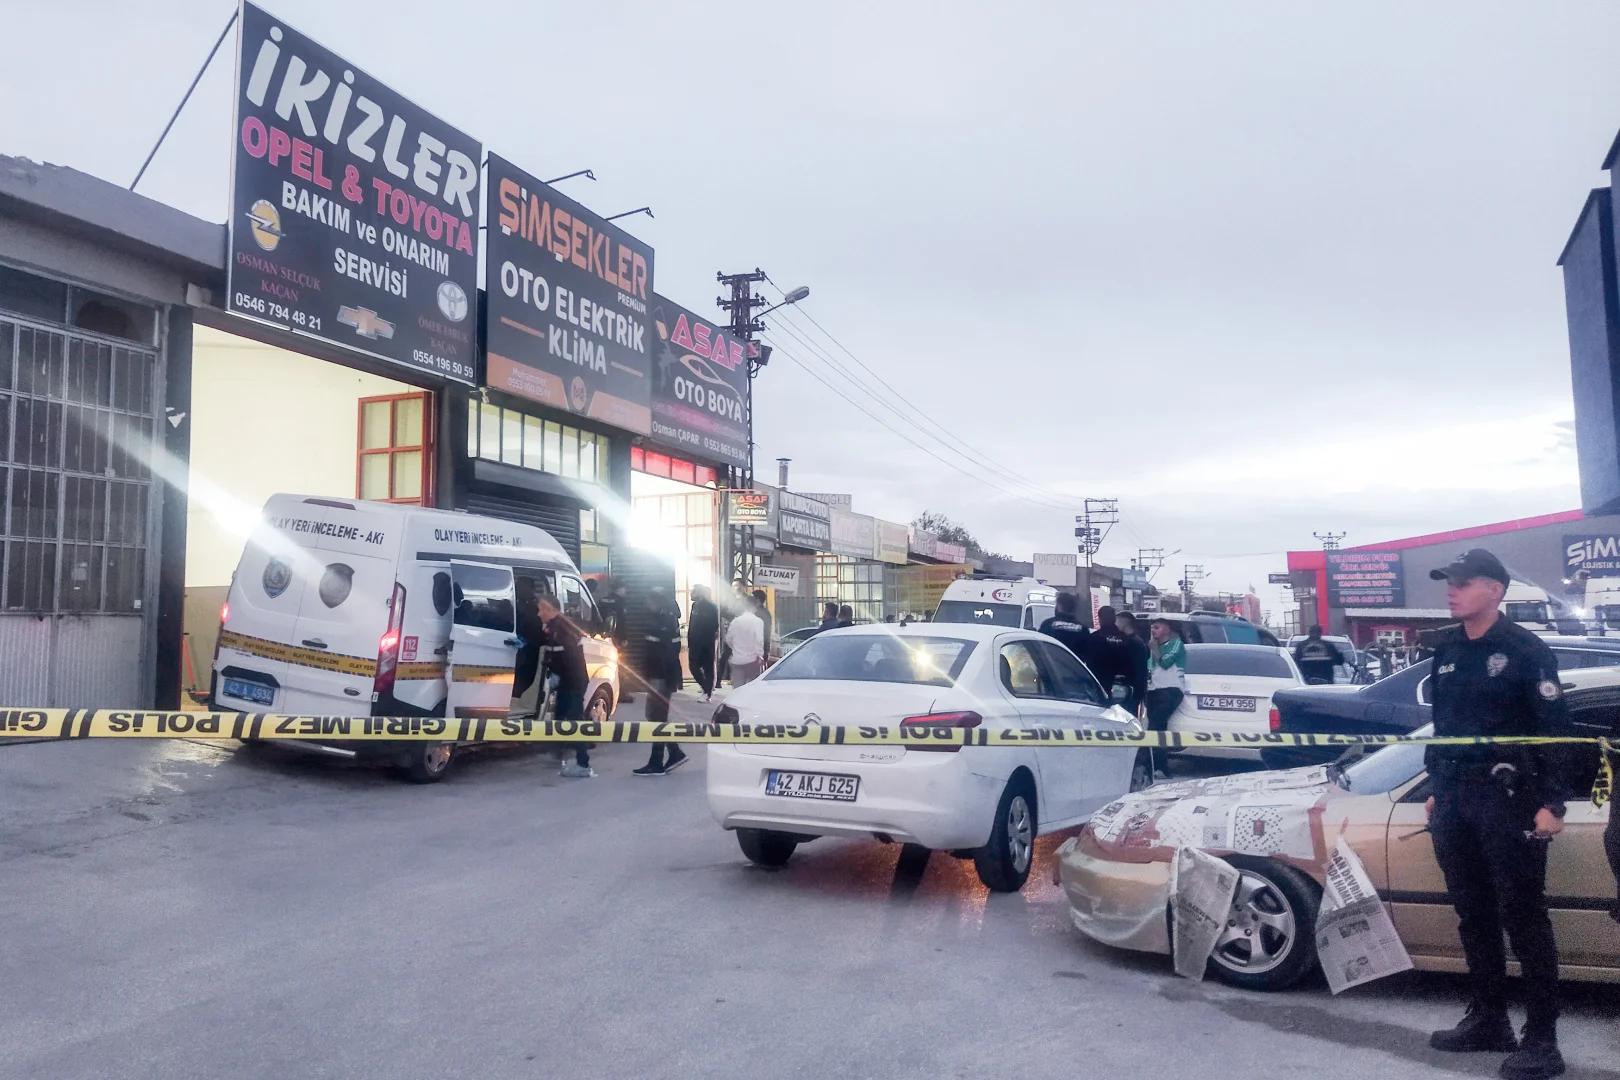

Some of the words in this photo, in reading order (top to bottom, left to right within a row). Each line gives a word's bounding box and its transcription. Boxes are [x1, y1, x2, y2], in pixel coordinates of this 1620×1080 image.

[246, 26, 478, 217] İKİZLER
[242, 116, 332, 190] OPEL
[341, 164, 363, 204] &
[372, 177, 474, 257] TOYOTA
[282, 181, 350, 234] BAKIM
[355, 219, 377, 244] ve
[382, 226, 450, 277] ONARIM
[499, 178, 647, 300] ŞİMŞEKLER
[236, 251, 278, 276] OSMAN
[280, 266, 321, 291] SELÇUK
[334, 247, 408, 299] SERVİSİ
[260, 279, 299, 302] KAÇAN
[235, 292, 265, 313] 0546
[268, 301, 290, 321] 794
[292, 310, 306, 326] 48
[308, 315, 321, 331] 21
[501, 260, 550, 312] OTO
[555, 285, 645, 353] ELEKTRİK
[549, 323, 607, 375] KLİMA
[671, 314, 745, 372] ASAF
[413, 349, 434, 365] 0554
[436, 356, 451, 371] 196
[452, 362, 463, 375] 50
[464, 365, 474, 378] 59
[674, 376, 705, 408] OTO
[708, 385, 743, 424] BOYA
[652, 420, 677, 438] Osman
[677, 428, 700, 446] ÇAPAR
[737, 495, 768, 503] ASAF
[750, 508, 767, 516] BOYA
[291, 517, 312, 533] YERİ
[311, 521, 359, 540] İNCELEME
[365, 530, 385, 545] AKİ
[434, 528, 453, 542] OLAY
[454, 530, 471, 544] YERİ
[471, 532, 504, 546] İNCELEME
[1567, 536, 1620, 566] ŞİM
[758, 568, 796, 580] ALTUNAY
[405, 639, 417, 651] 112
[1203, 697, 1215, 707] 42
[1219, 698, 1234, 707] EM
[1236, 699, 1254, 708] 956
[108, 712, 220, 733] POLİS
[501, 719, 602, 736] POLİS
[777, 774, 793, 789] 42
[798, 775, 823, 792] AKJ
[828, 777, 854, 795] 625
